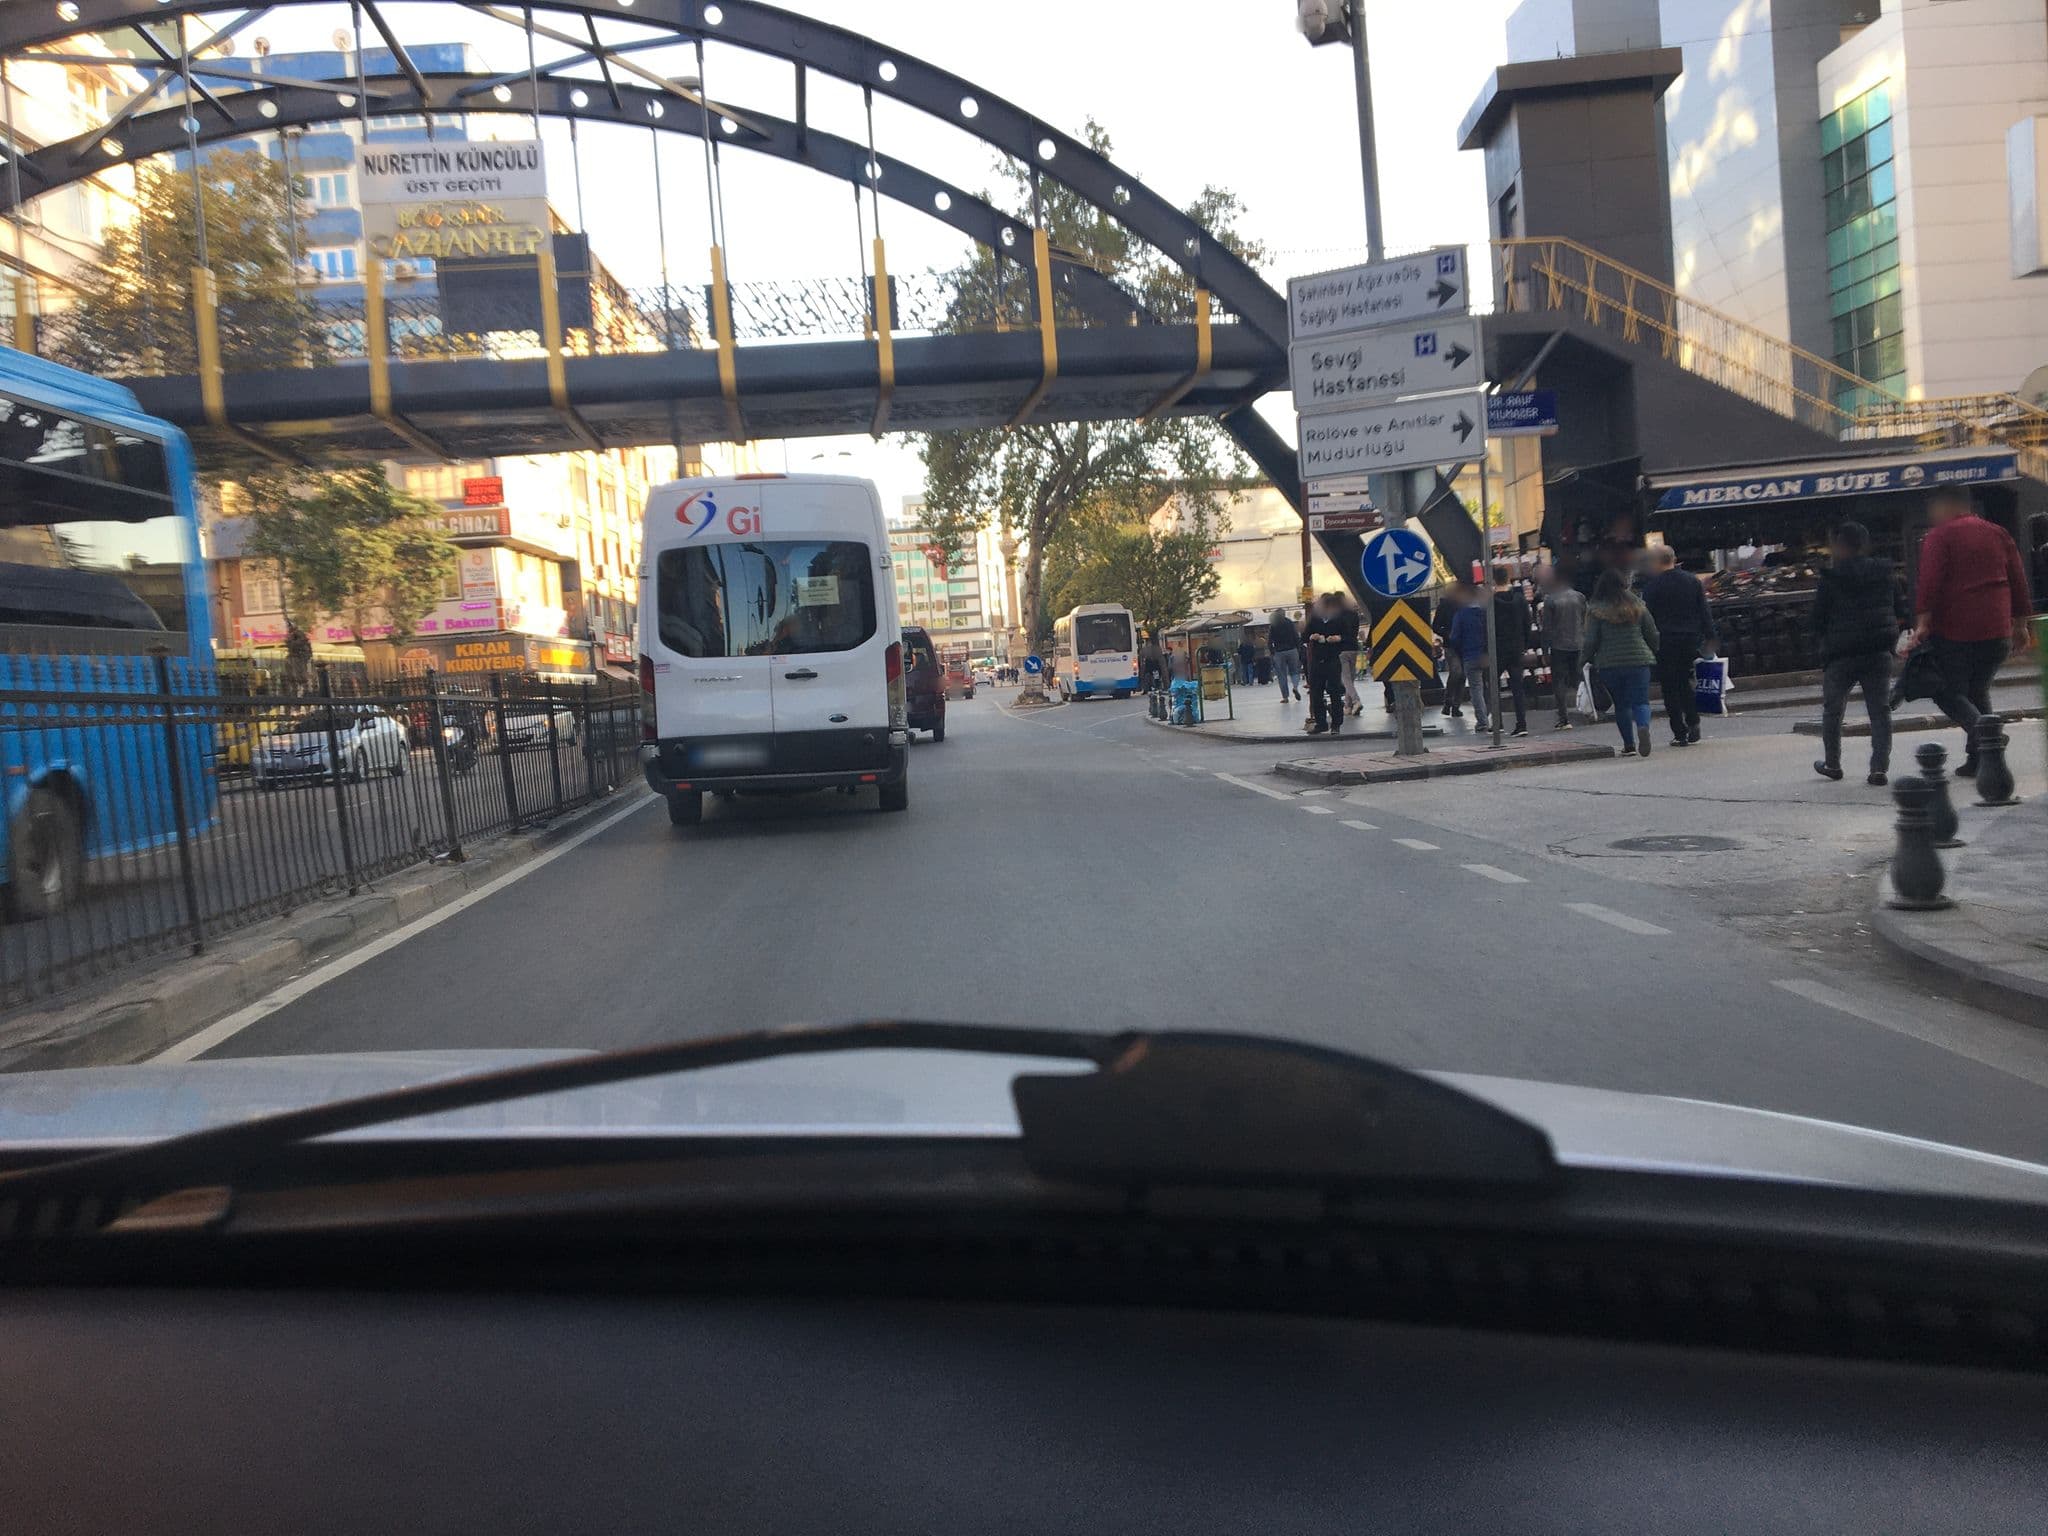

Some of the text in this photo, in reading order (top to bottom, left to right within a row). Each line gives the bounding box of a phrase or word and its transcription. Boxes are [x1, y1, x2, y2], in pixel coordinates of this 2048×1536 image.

[364, 145, 538, 176] NURETTİN KÜNCÜLÜ
[406, 177, 502, 195] ÜST GEÇİTİ
[1311, 347, 1363, 371] Sevgi
[1312, 367, 1406, 397] Hastanesi
[1364, 422, 1383, 435] ve
[1682, 479, 1804, 505] MERCAN
[1816, 470, 1891, 493] BÜFE
[727, 506, 761, 535] Gi
[455, 641, 510, 657] KIRAN
